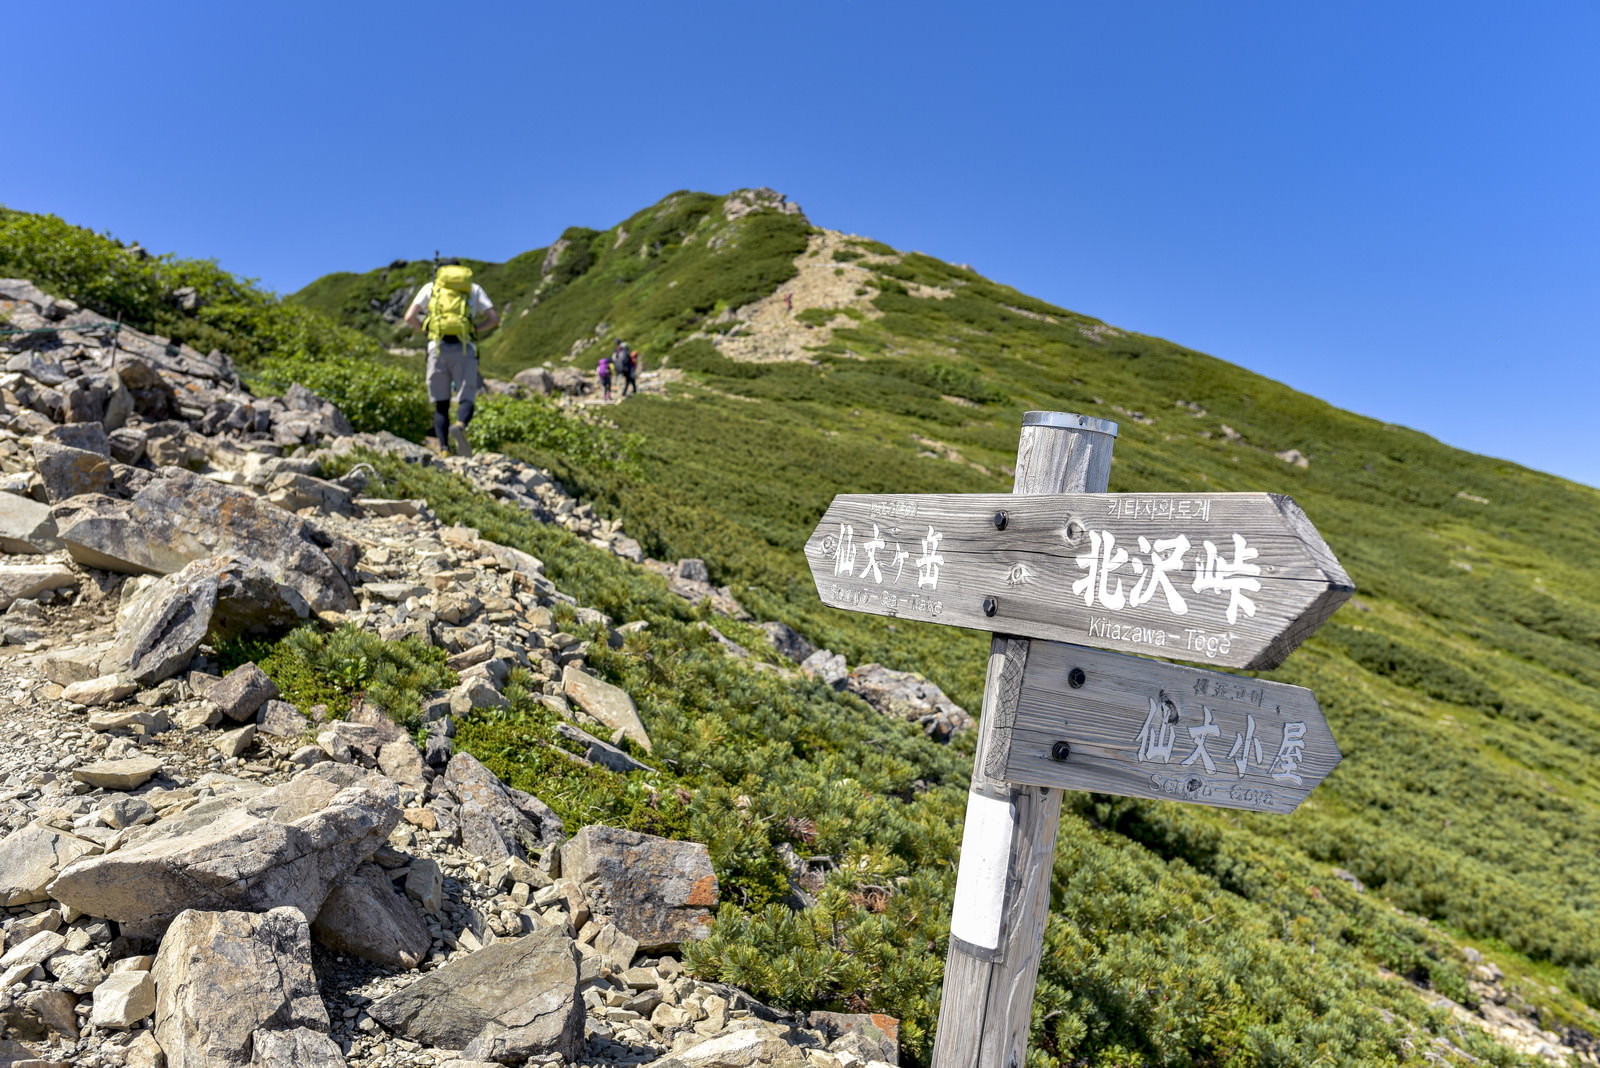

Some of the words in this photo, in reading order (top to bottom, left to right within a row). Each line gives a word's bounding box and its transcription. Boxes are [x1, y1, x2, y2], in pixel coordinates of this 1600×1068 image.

[1107, 499, 1211, 522] 키타자와토게
[1072, 529, 1262, 625] 北沢峠
[1133, 696, 1307, 786] 仙丈小屋
